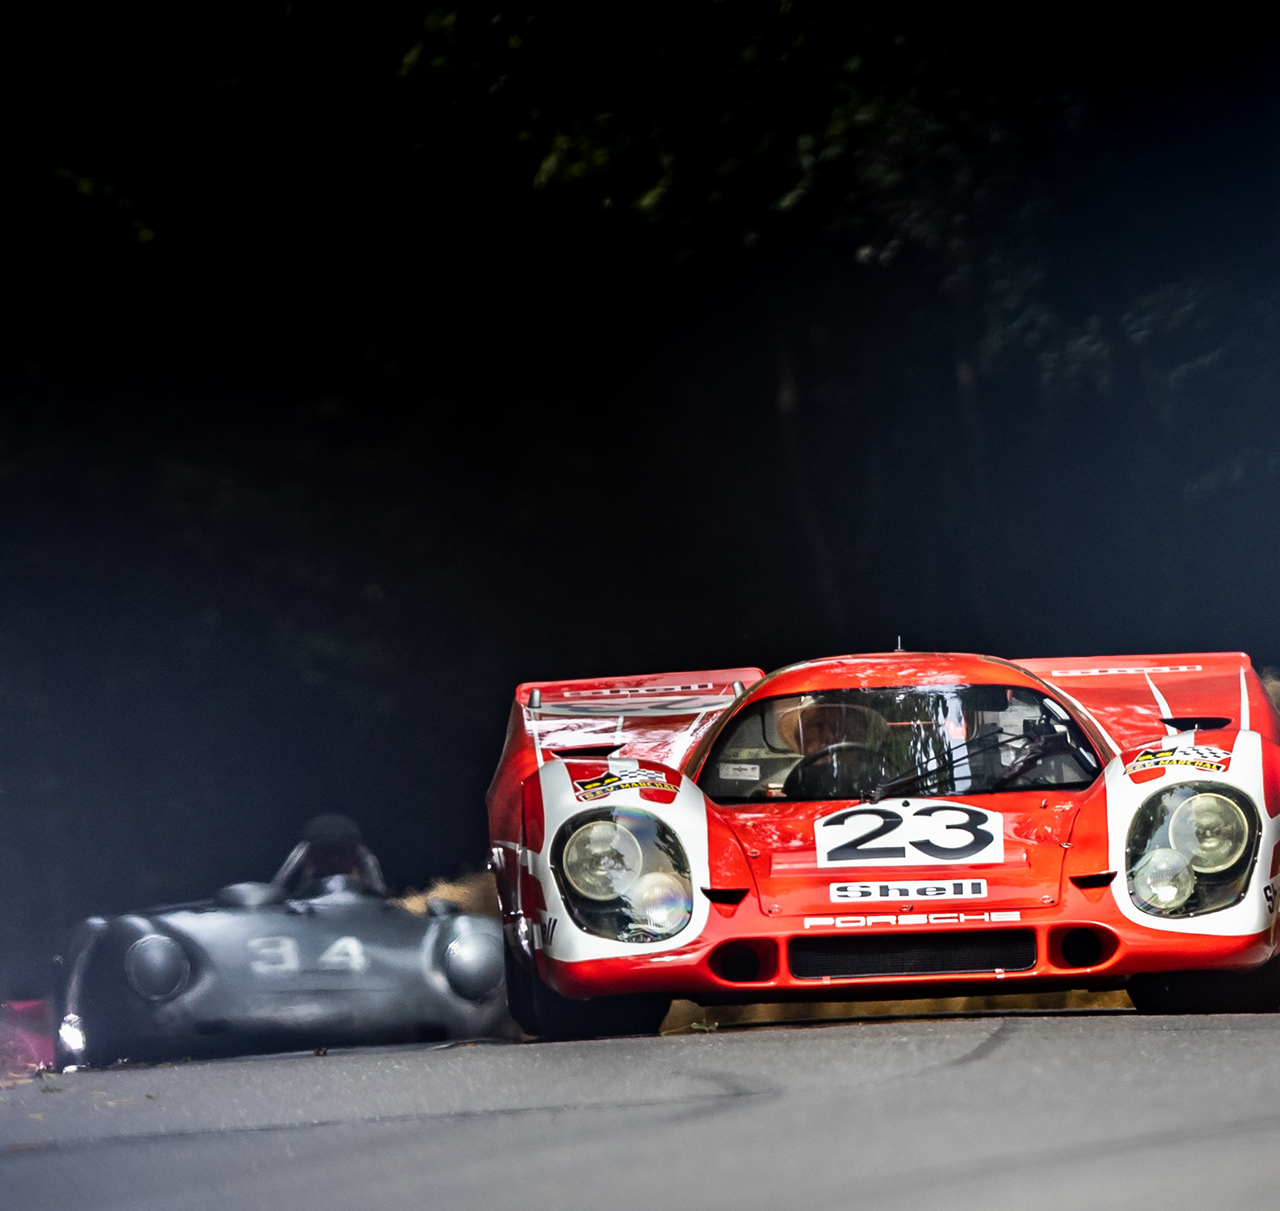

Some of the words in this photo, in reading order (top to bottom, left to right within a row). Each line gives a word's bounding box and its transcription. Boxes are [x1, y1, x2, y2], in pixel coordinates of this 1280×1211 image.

[1159, 759, 1218, 771] MARCHAL
[620, 782, 677, 792] MARCHAL
[822, 805, 995, 861] 23
[836, 882, 982, 898] Shell
[804, 911, 1021, 929] PORSCHE
[246, 935, 367, 976] 34
